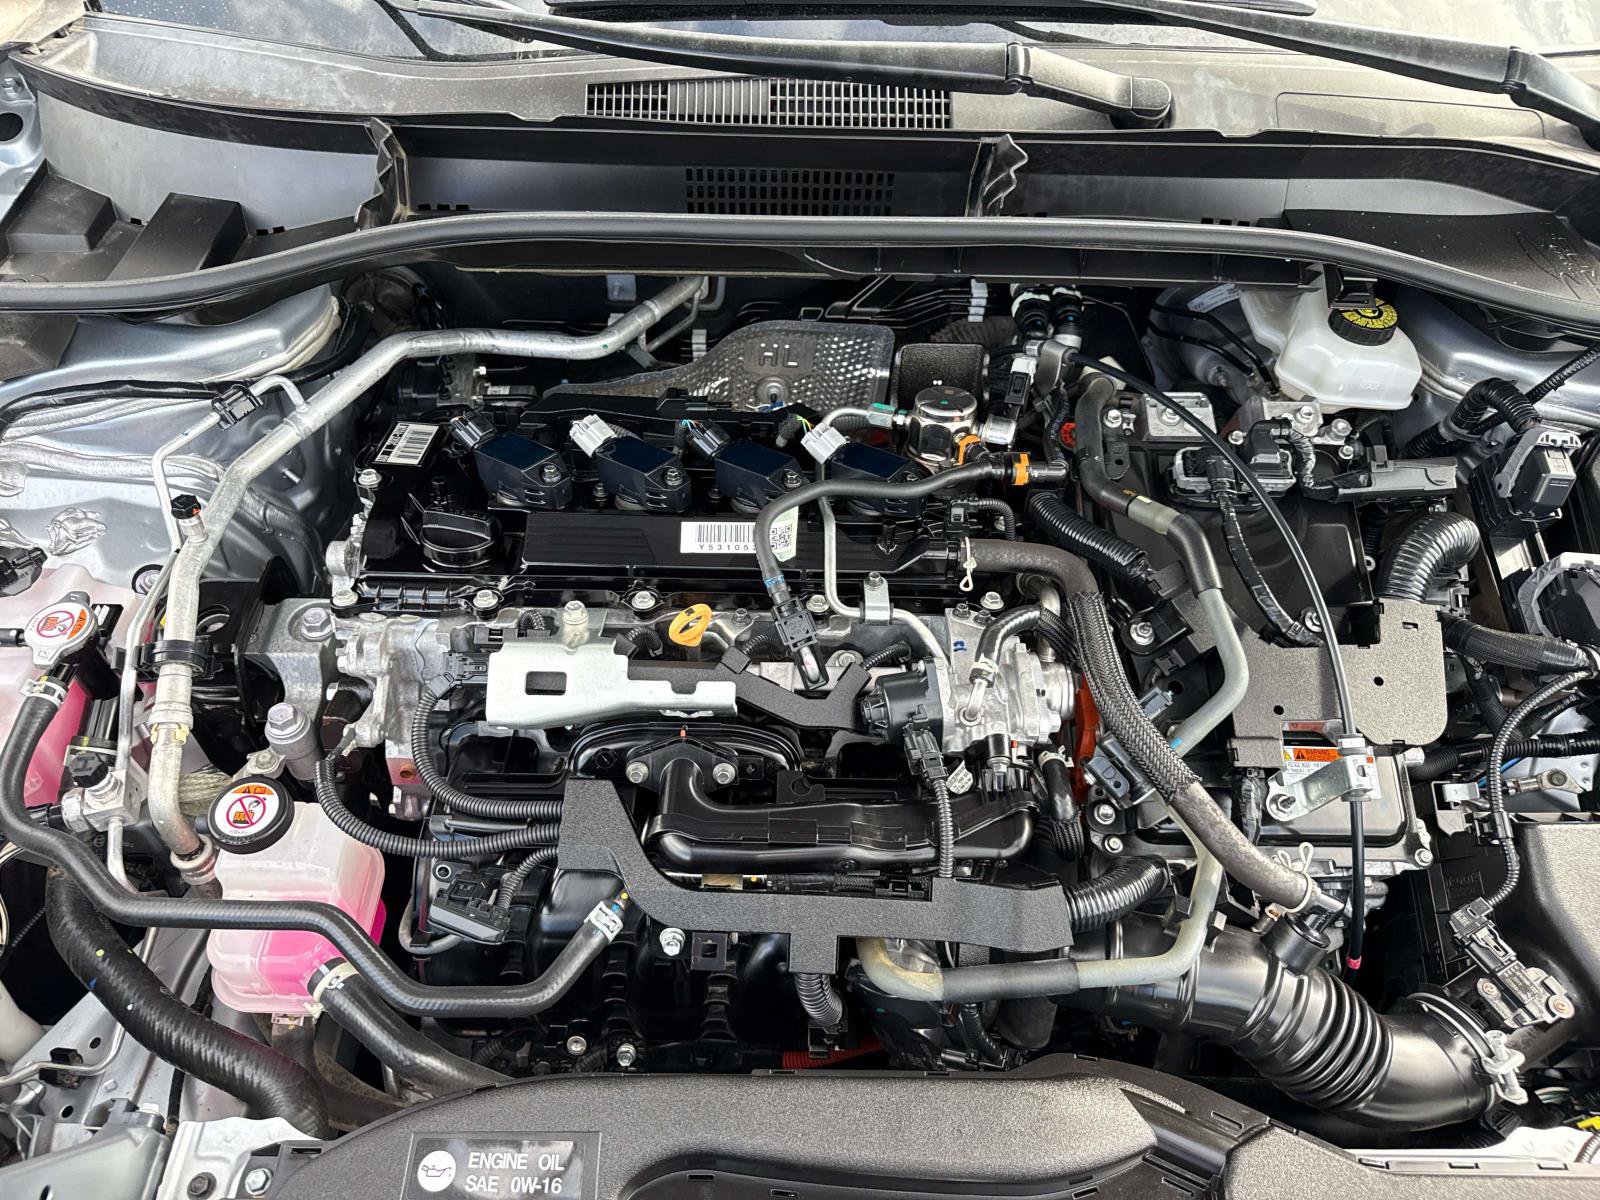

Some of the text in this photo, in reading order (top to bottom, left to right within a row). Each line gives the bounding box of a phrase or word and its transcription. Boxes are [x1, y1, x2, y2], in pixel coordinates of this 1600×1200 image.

[468, 1152, 565, 1171] ENGINE OIL
[465, 1174, 562, 1194] SAE 0W-16
